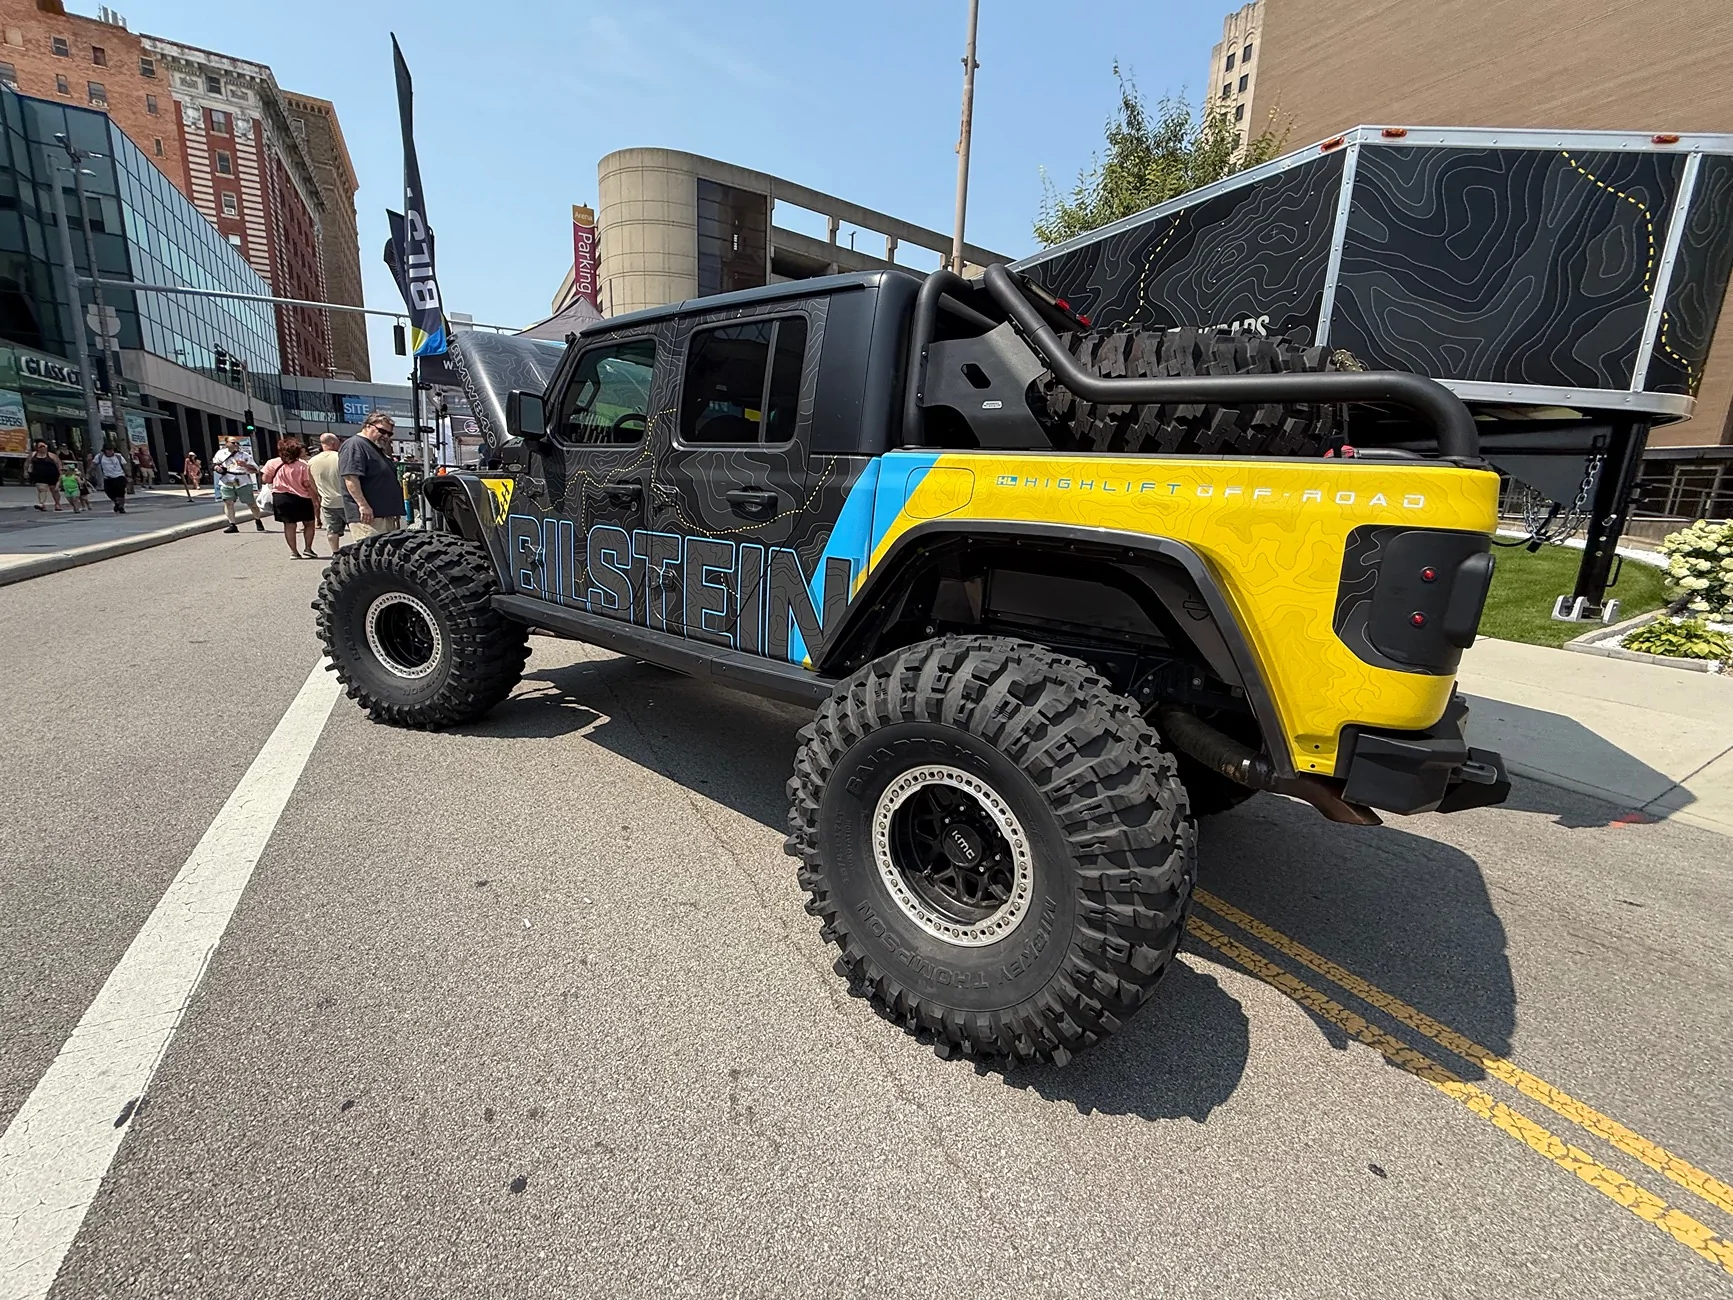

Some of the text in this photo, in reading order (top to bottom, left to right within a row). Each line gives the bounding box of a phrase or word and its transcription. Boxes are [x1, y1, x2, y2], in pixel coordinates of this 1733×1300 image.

[407, 187, 439, 310] BILS
[574, 211, 593, 221] Arena
[576, 231, 594, 294] Parking
[1024, 476, 1182, 495] HIGHLIFT
[1196, 484, 1426, 509] OFF-ROAD
[508, 514, 855, 668] BILSTEIN
[856, 895, 1057, 992] MICKEY THOMPSON
